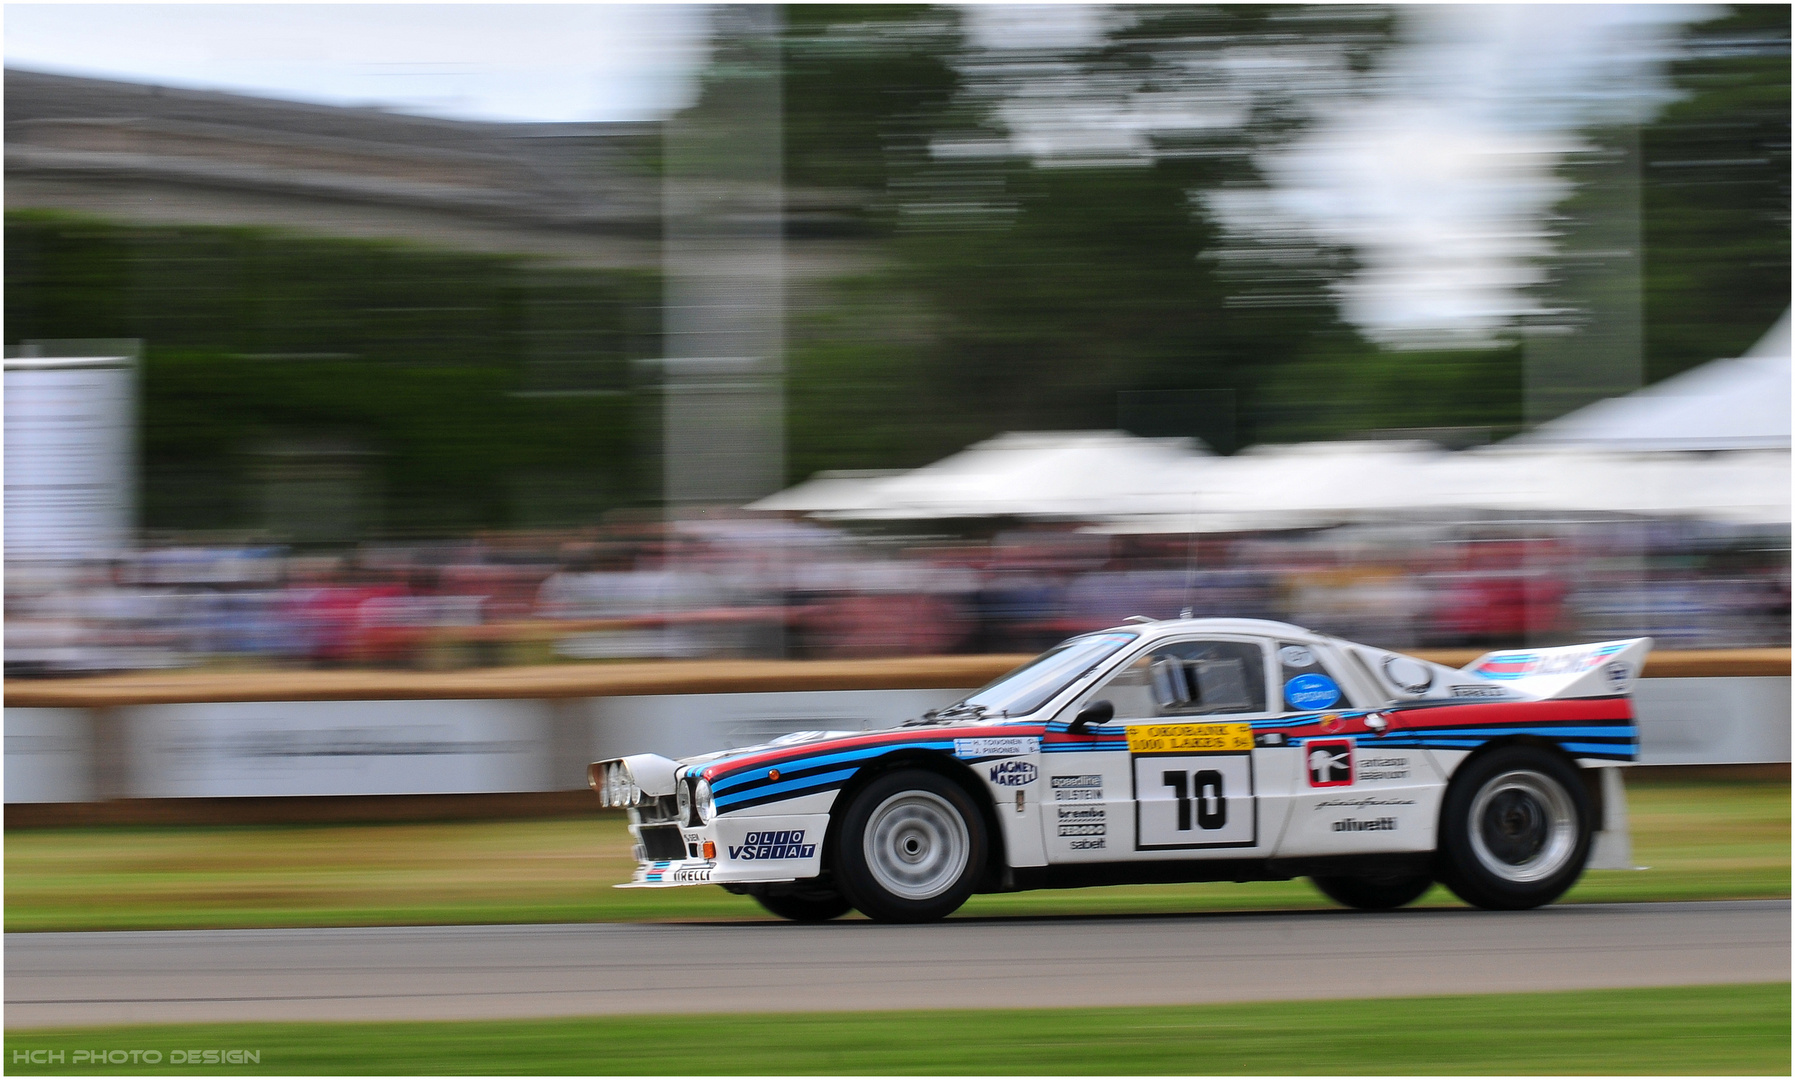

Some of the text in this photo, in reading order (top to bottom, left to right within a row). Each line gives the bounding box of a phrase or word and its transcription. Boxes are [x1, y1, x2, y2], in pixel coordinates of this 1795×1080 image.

[1147, 726, 1230, 737] OKOBANK
[1132, 739, 1164, 750] 1000
[1171, 738, 1225, 749] LAKES
[1055, 789, 1103, 801] BILSTEIN
[1162, 769, 1226, 831] 10
[1058, 807, 1106, 818] brembo
[1060, 825, 1105, 836] FERODO
[1331, 817, 1397, 832] olivetti
[746, 830, 803, 845] OLIO
[1070, 838, 1106, 850] sabelt
